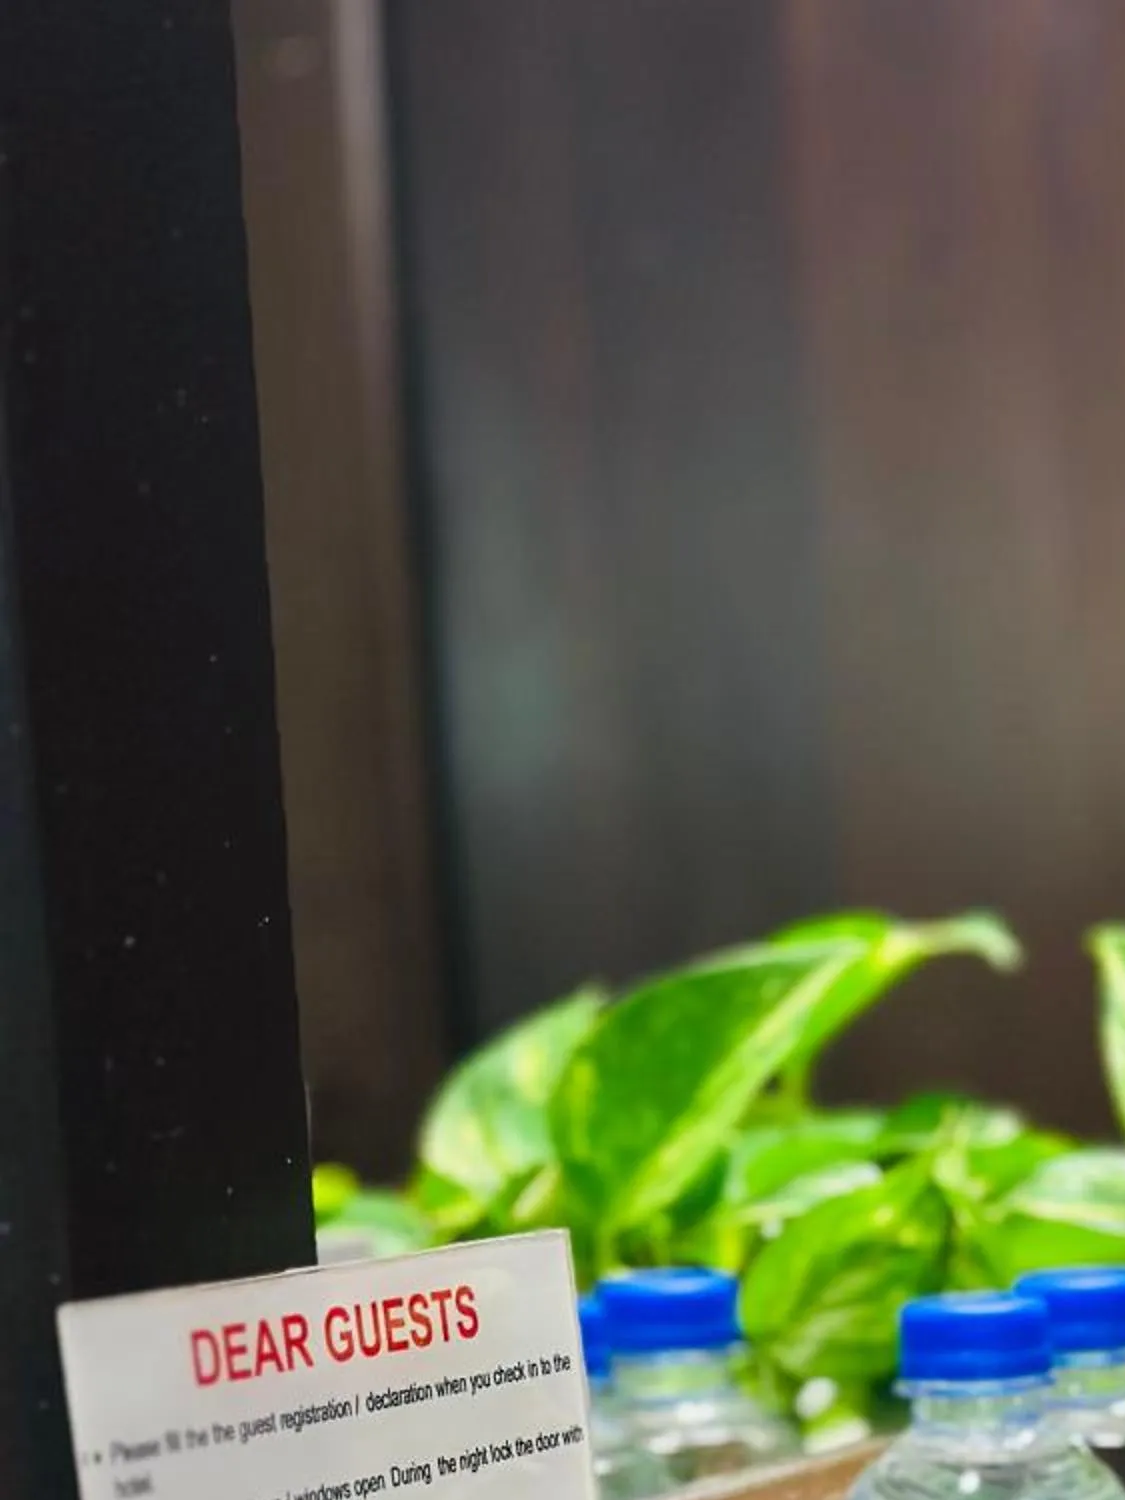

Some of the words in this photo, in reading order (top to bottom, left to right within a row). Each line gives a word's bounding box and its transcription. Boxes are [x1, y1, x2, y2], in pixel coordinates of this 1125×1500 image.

[191, 1313, 314, 1386] DEAR
[323, 1285, 478, 1363] GUESTS
[212, 1420, 235, 1444] the
[239, 1411, 277, 1444] guest
[280, 1399, 353, 1432] registration
[366, 1380, 433, 1412] declaration
[435, 1376, 467, 1398] when
[470, 1373, 490, 1396] you
[493, 1359, 525, 1387] check
[528, 1358, 539, 1373] in
[540, 1358, 552, 1371] to
[553, 1353, 570, 1370] the
[354, 1473, 386, 1498] open
[391, 1461, 432, 1484] During
[437, 1455, 457, 1475] the
[460, 1446, 489, 1472] night
[490, 1442, 514, 1464] lock
[515, 1436, 534, 1456] the
[536, 1431, 561, 1451] door
[562, 1424, 583, 1445] with
